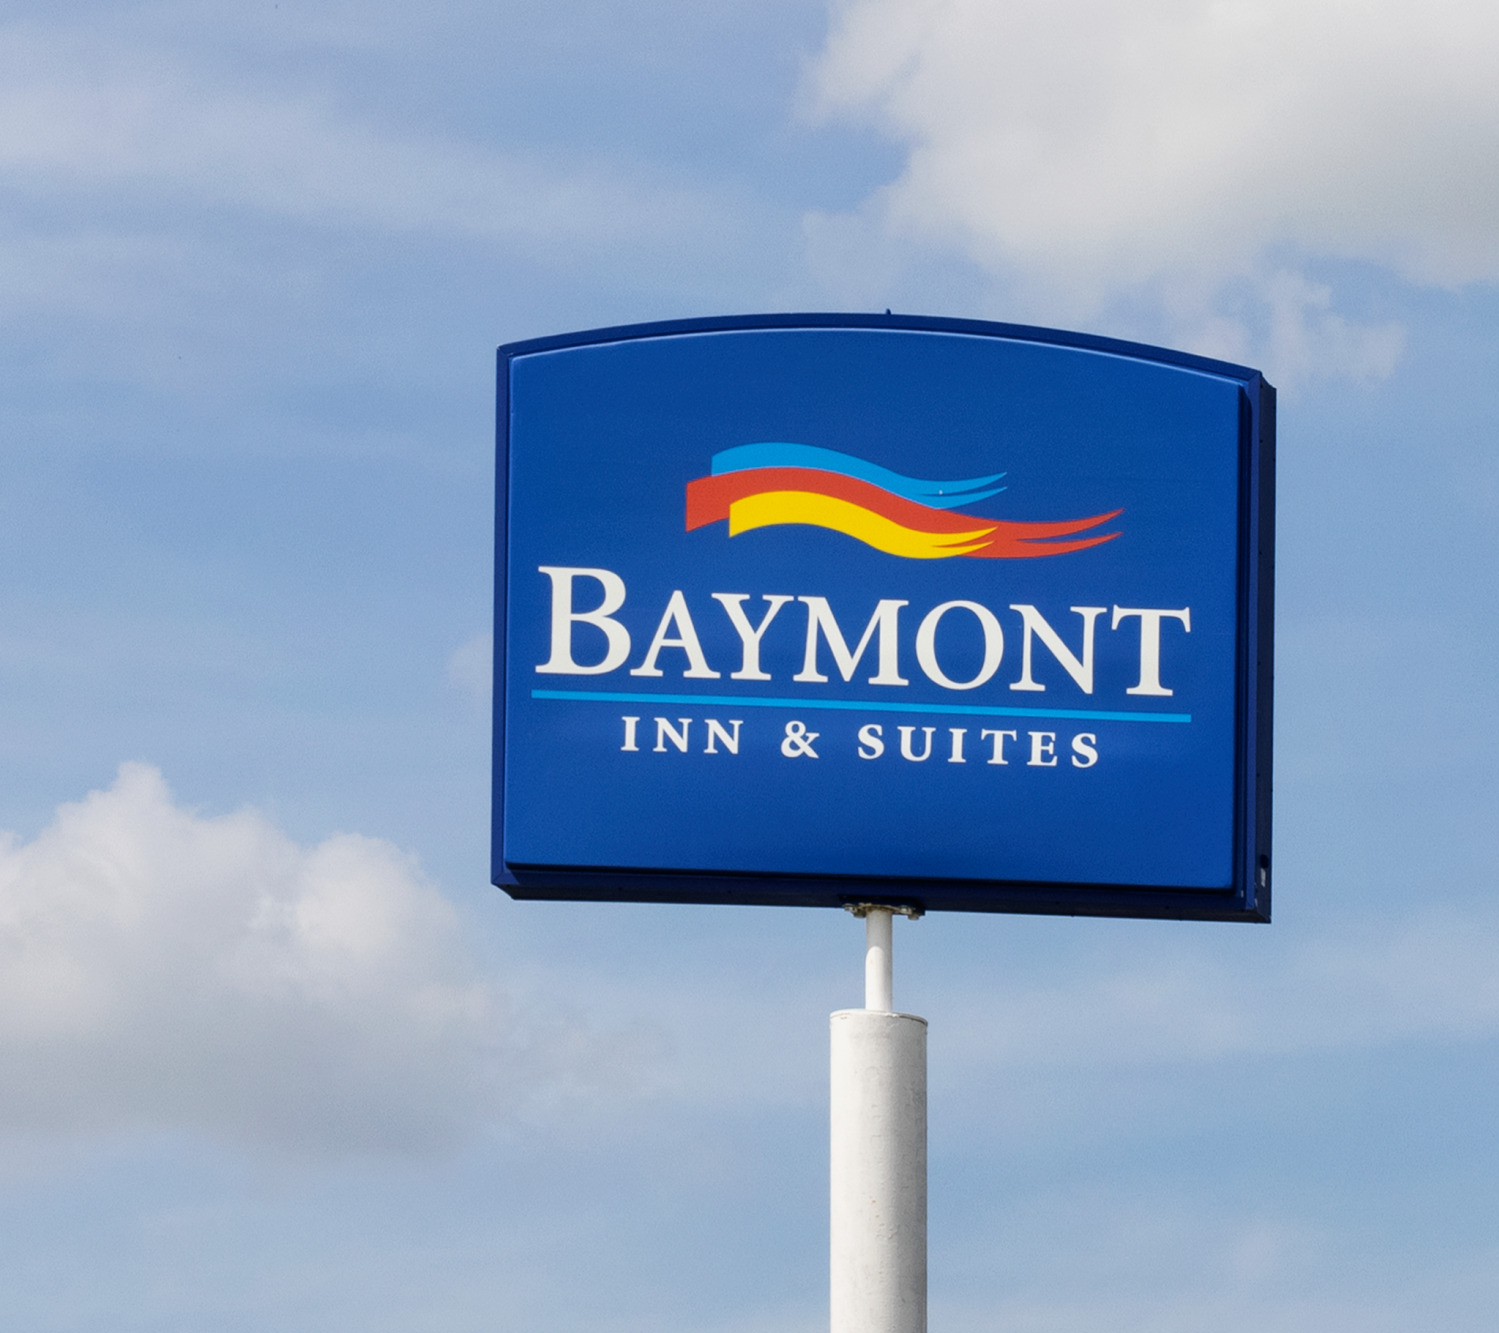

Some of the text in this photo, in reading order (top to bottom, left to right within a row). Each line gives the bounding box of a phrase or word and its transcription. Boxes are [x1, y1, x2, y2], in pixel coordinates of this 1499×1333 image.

[536, 566, 1191, 696] BAYMONT
[621, 717, 1099, 768] INN & SUITES
